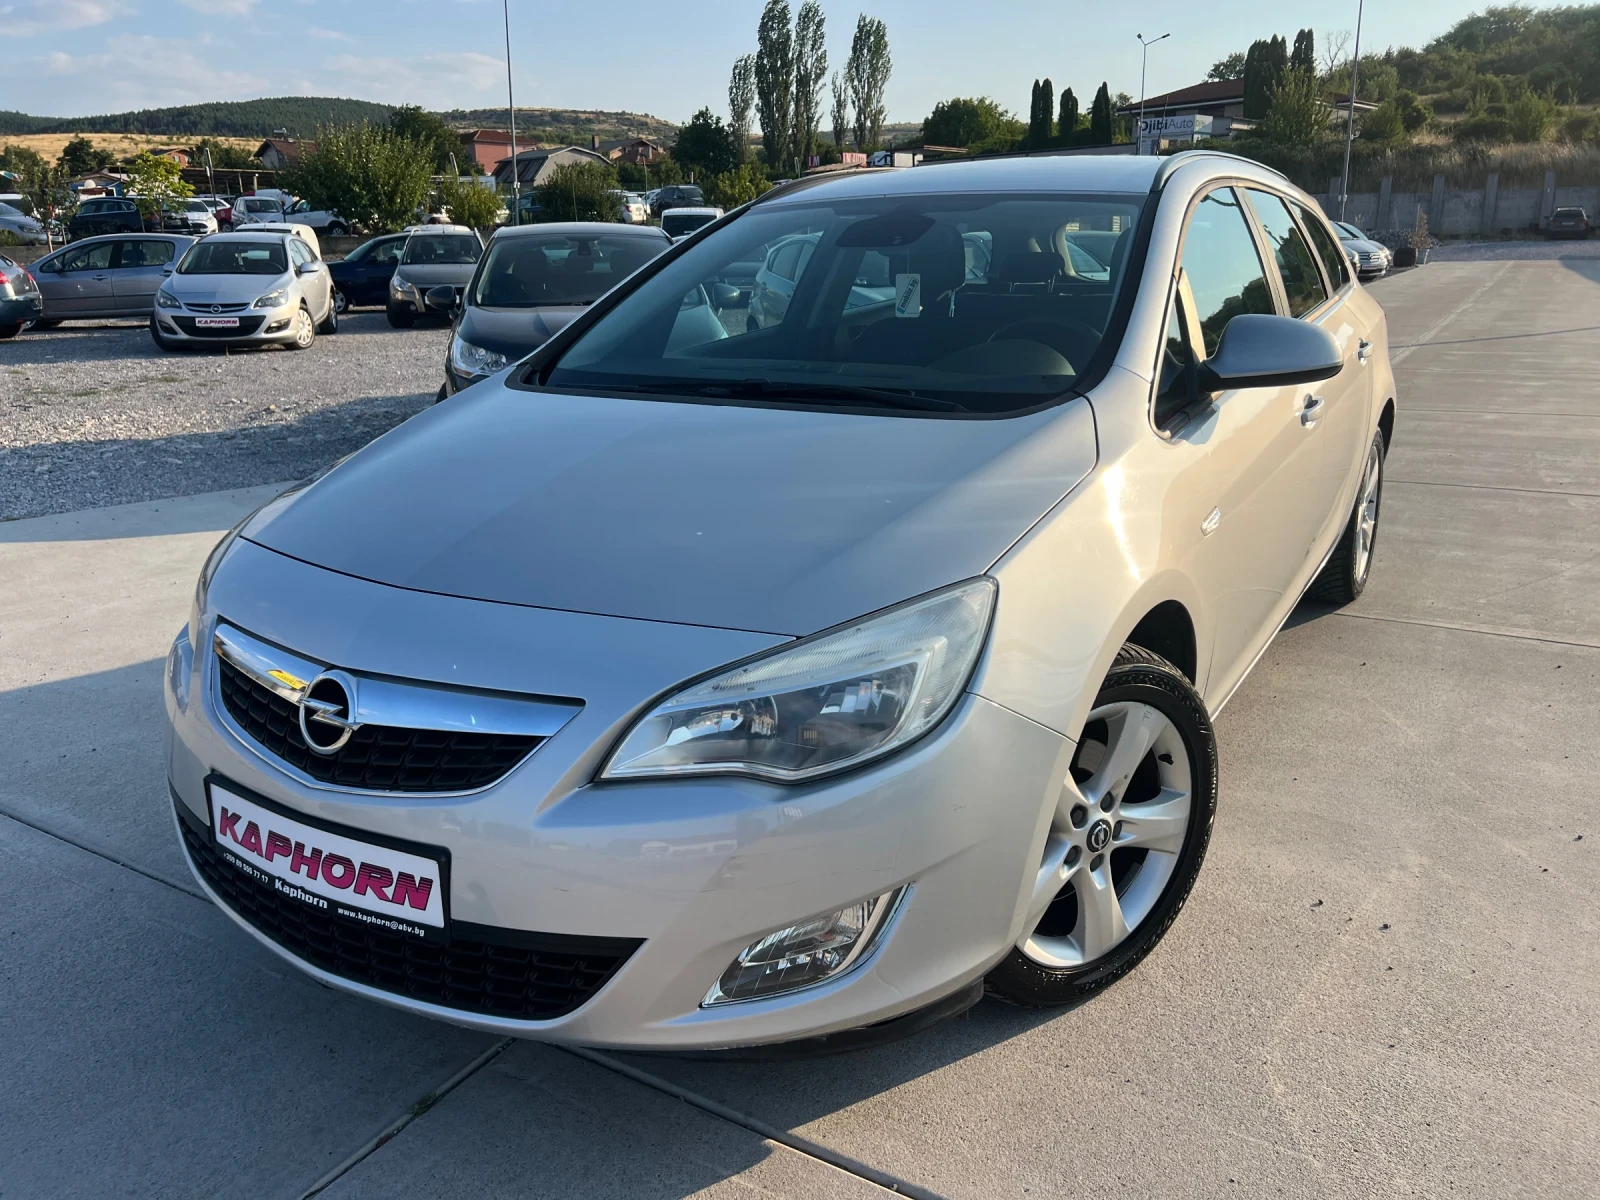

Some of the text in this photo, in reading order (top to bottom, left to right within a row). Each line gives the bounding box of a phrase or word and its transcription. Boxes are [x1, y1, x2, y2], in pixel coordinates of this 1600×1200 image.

[219, 806, 433, 911] KAPHORN
[261, 874, 269, 883] 17
[275, 879, 328, 909] Kaphorn
[337, 907, 425, 937] www.kaphorn@abv.bg
